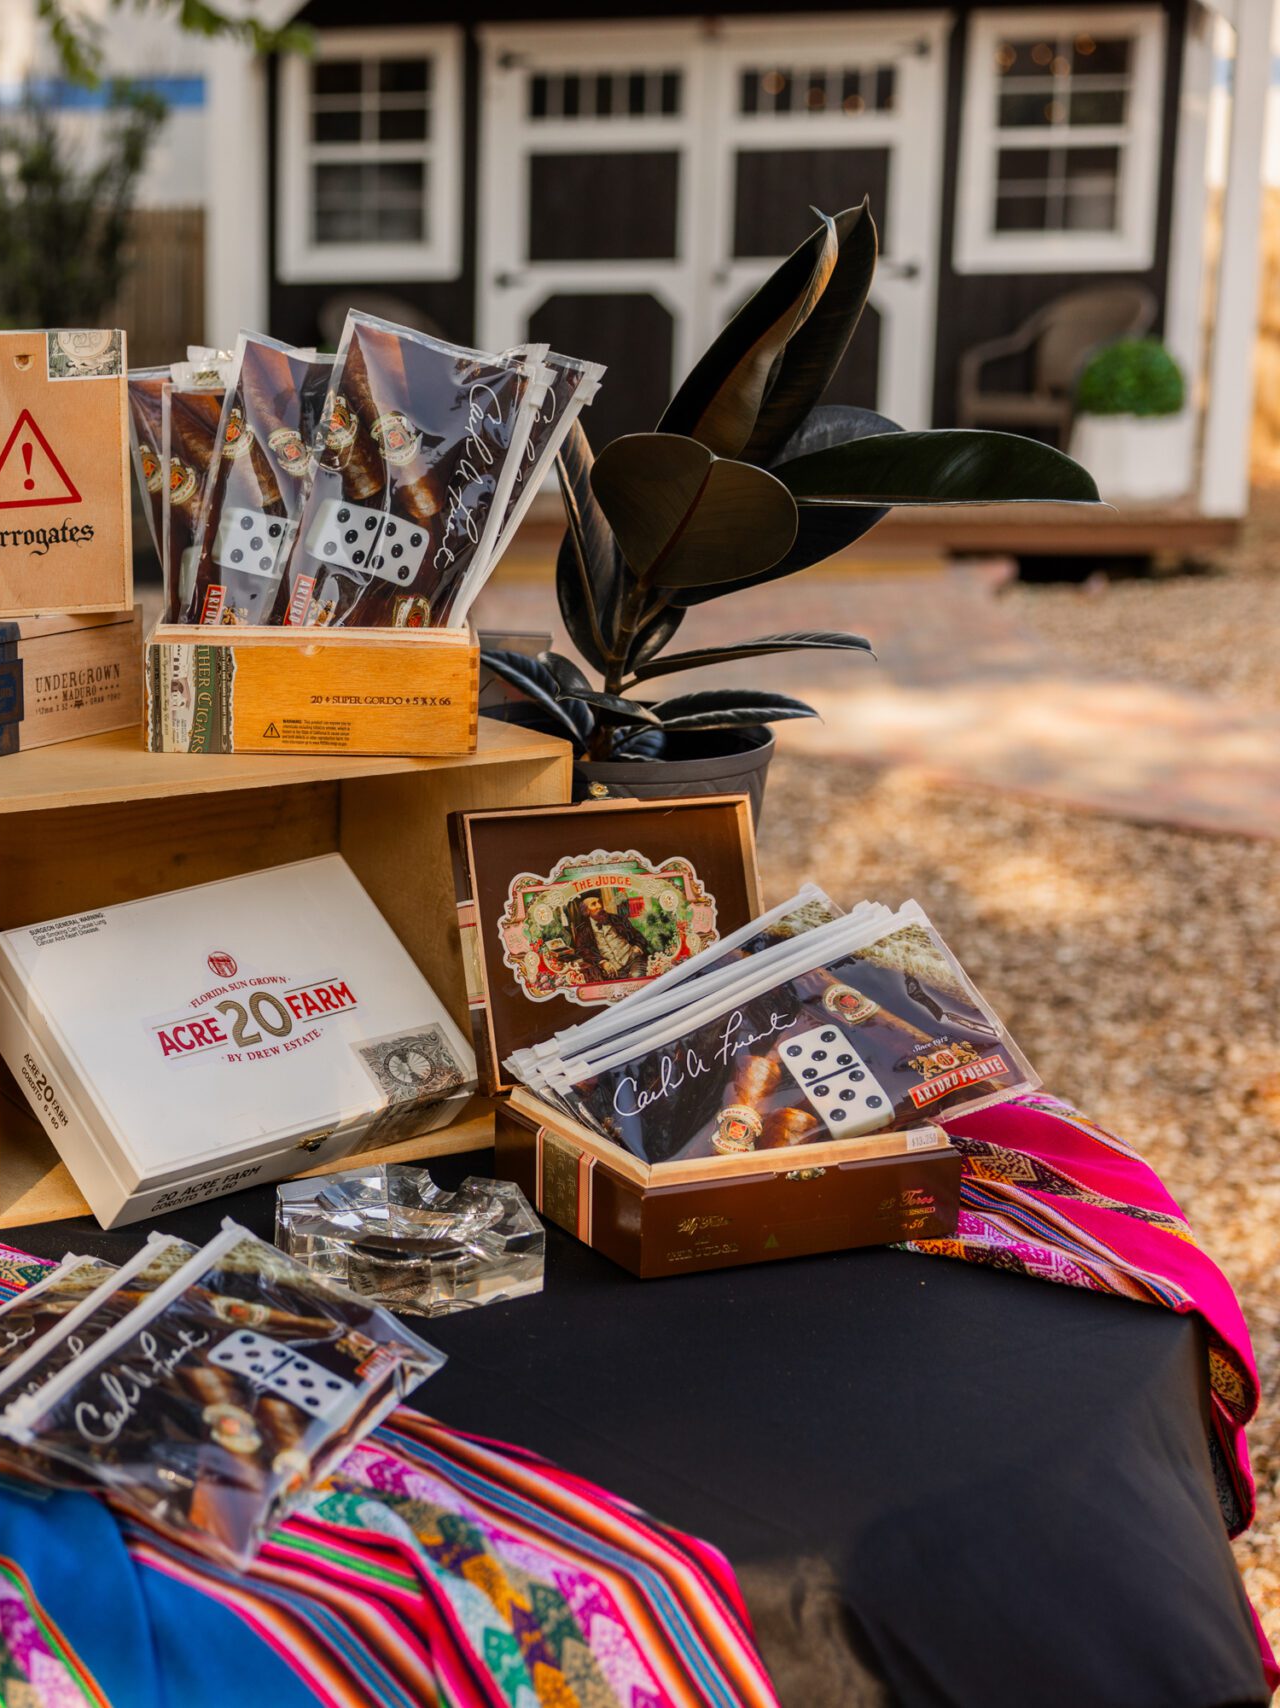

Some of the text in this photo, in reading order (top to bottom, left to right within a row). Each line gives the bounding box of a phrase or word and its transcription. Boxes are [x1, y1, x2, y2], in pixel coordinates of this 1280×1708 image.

[35, 663, 120, 693] UNDERCROWN
[62, 685, 97, 702] MADURO
[311, 695, 323, 704] 20
[332, 695, 362, 704] SUPER
[364, 696, 402, 705] GORDO
[439, 697, 451, 706] 66
[191, 692, 213, 753] CIGARS
[571, 875, 632, 893] THE JUDGE
[55, 919, 80, 929] GENERAL
[191, 975, 287, 1009] FLORIDA SUN GROWN
[157, 981, 357, 1056] ACRE 20 FARM
[228, 1028, 321, 1063] BY DREW ESTATE
[21, 1066, 42, 1101] GORDITO
[43, 1104, 49, 1112] 6
[51, 1116, 59, 1129] 60
[23, 1053, 68, 1127] ACRE 20 FARM
[915, 1058, 1004, 1103] ARTURO FUENTE
[157, 1165, 262, 1203] 20 ACRE FARM
[151, 1193, 198, 1212] GORDITO
